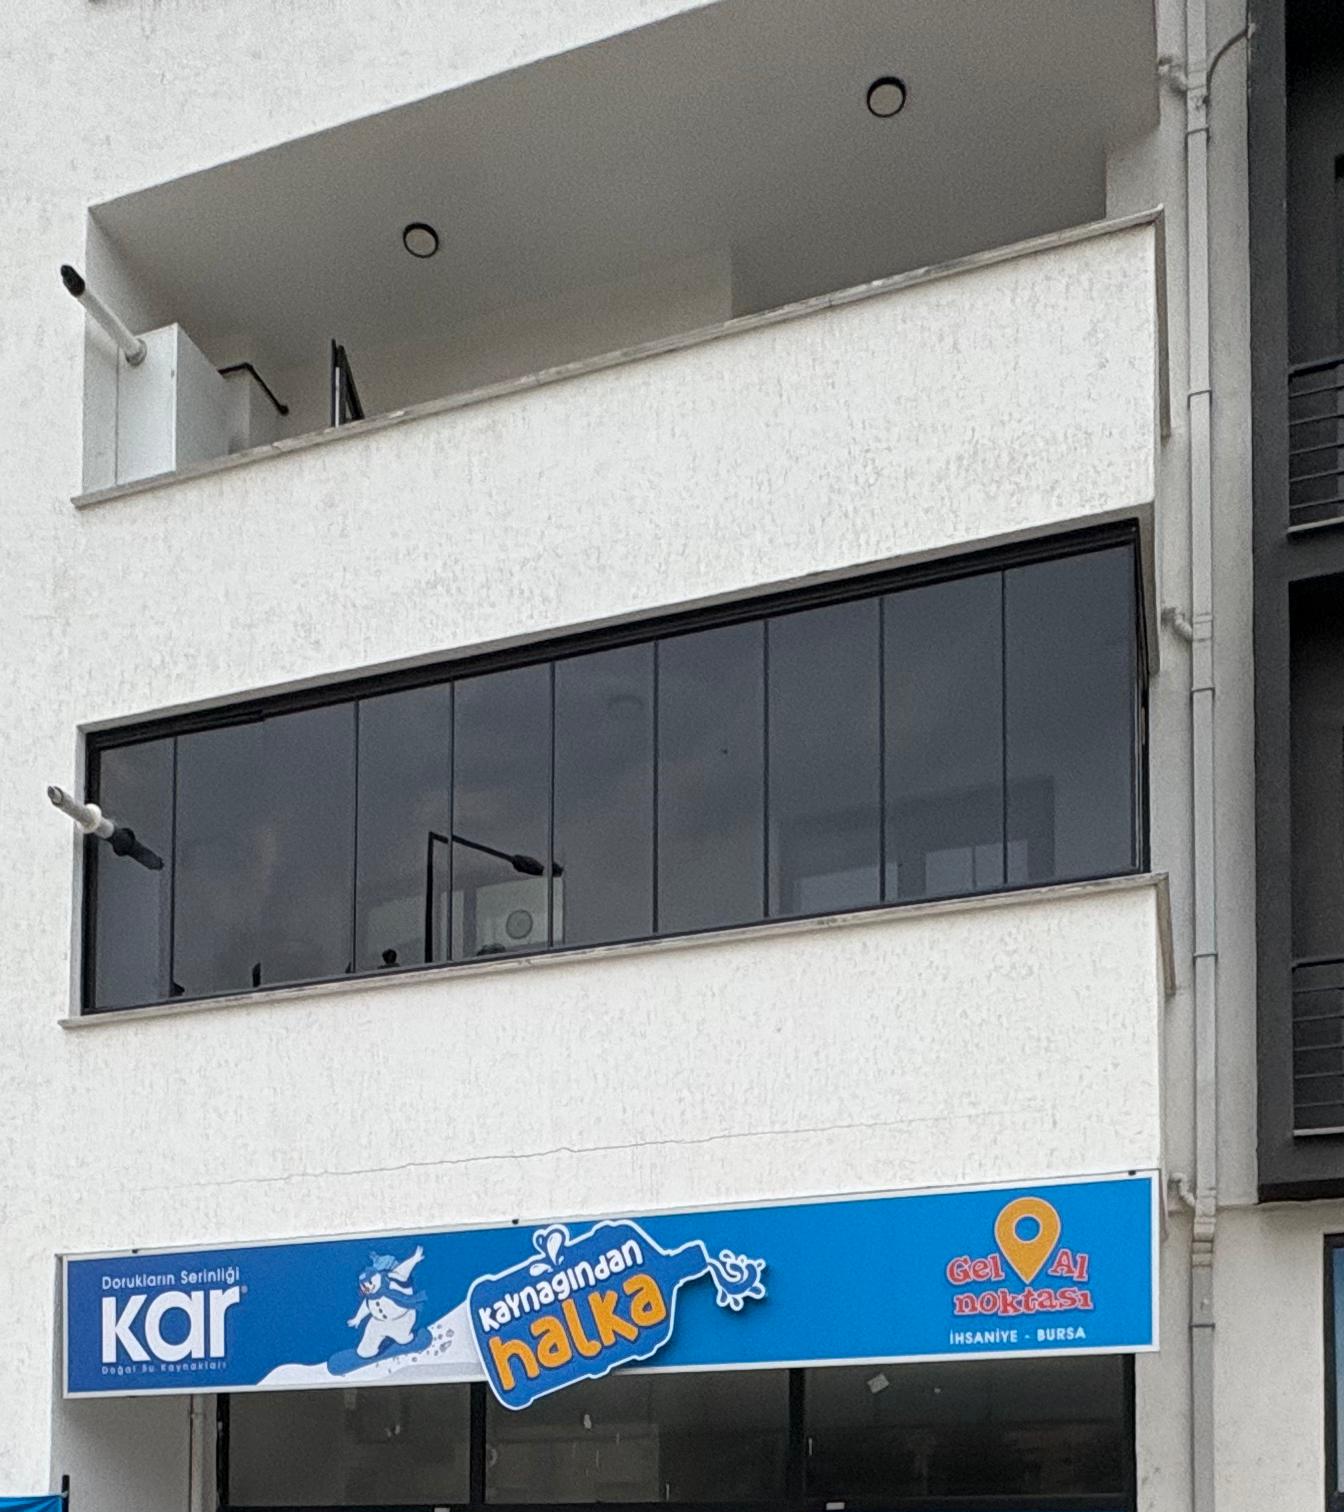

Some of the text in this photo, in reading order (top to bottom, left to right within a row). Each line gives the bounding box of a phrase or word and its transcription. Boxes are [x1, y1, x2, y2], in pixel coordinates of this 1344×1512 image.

[102, 1266, 239, 1290] Dorukların Serinliği
[947, 1249, 1088, 1285] Gel Al
[954, 1287, 1093, 1315] noktası
[102, 1285, 240, 1364] kar
[489, 1274, 667, 1390] halka
[949, 1328, 1018, 1345] İHSANİYE
[1037, 1327, 1086, 1341] BURSA
